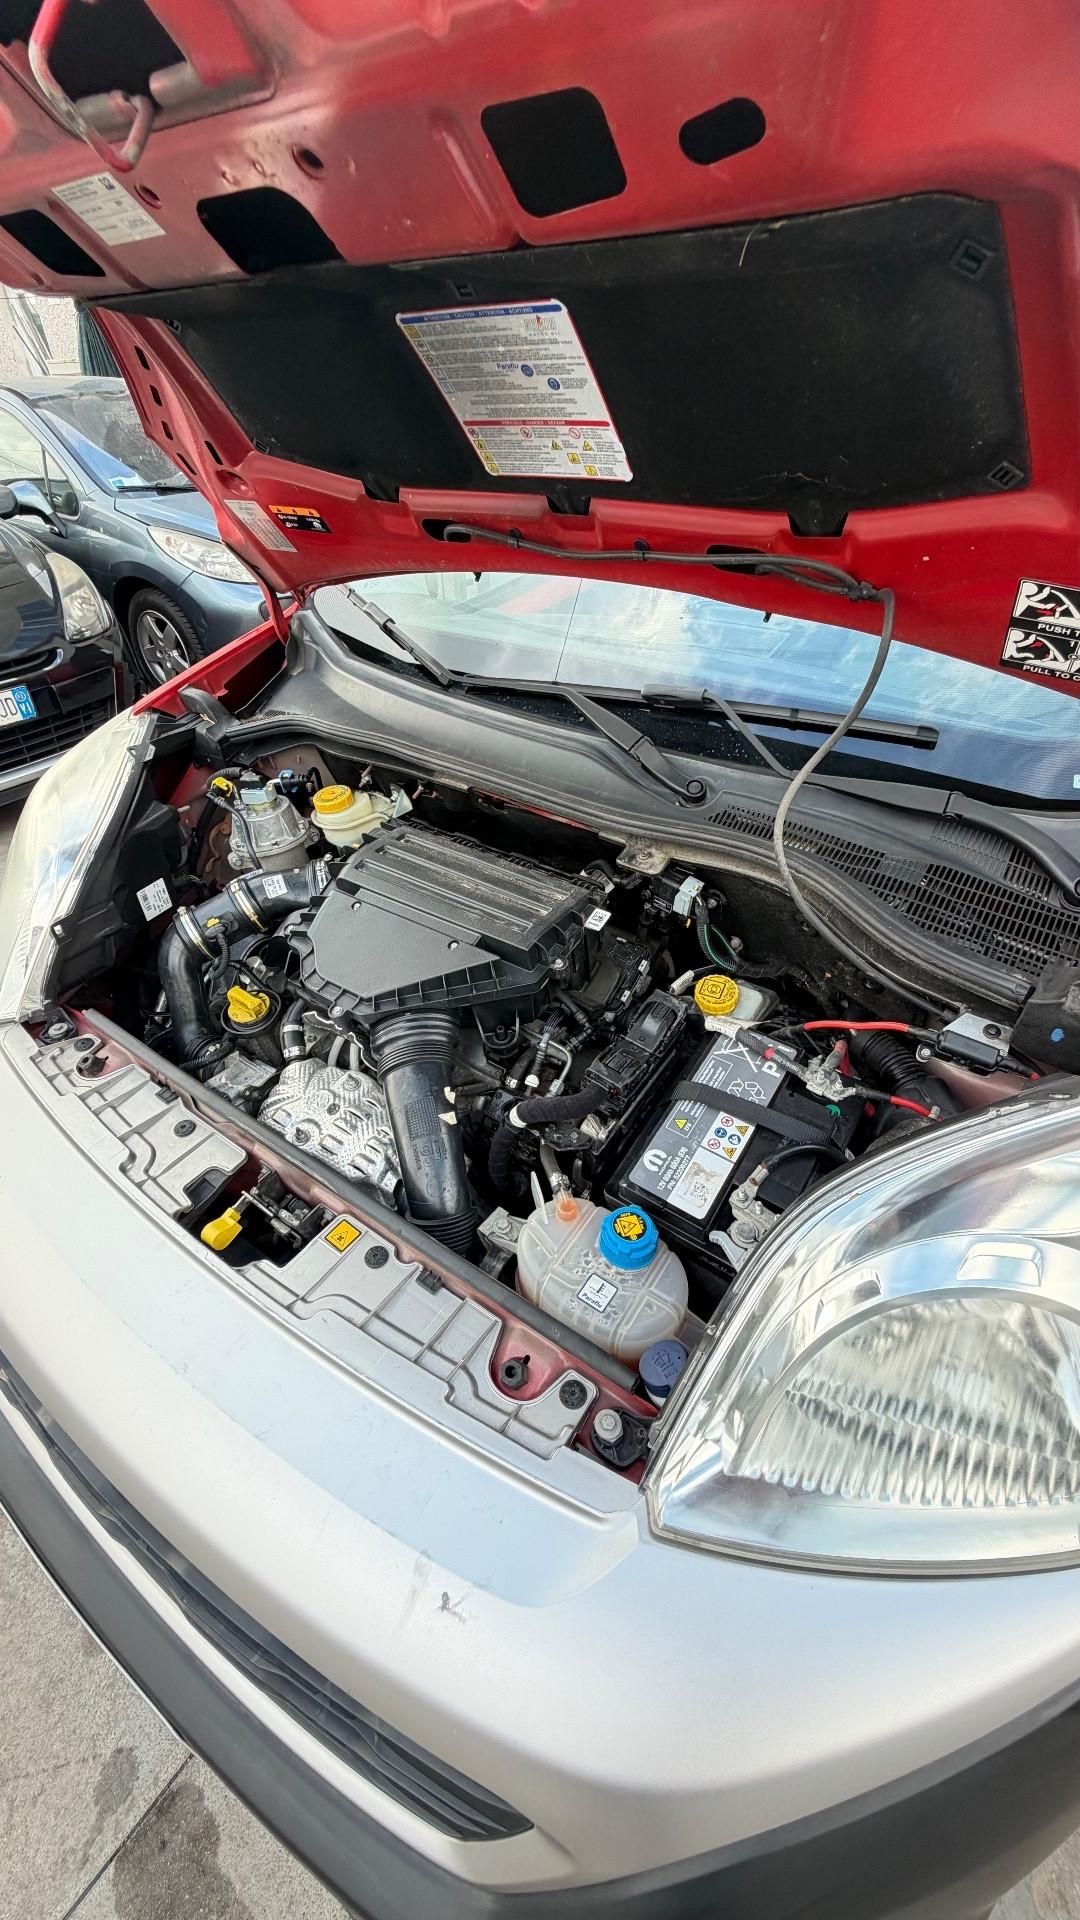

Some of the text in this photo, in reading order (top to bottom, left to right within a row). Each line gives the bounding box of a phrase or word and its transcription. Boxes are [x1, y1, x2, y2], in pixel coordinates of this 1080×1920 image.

[1038, 624, 1070, 635] PUSH
[1023, 664, 1051, 676] PULL
[1055, 671, 1070, 679] TO
[657, 1180, 667, 1190] 12V
[582, 1292, 603, 1308] Paraflu
